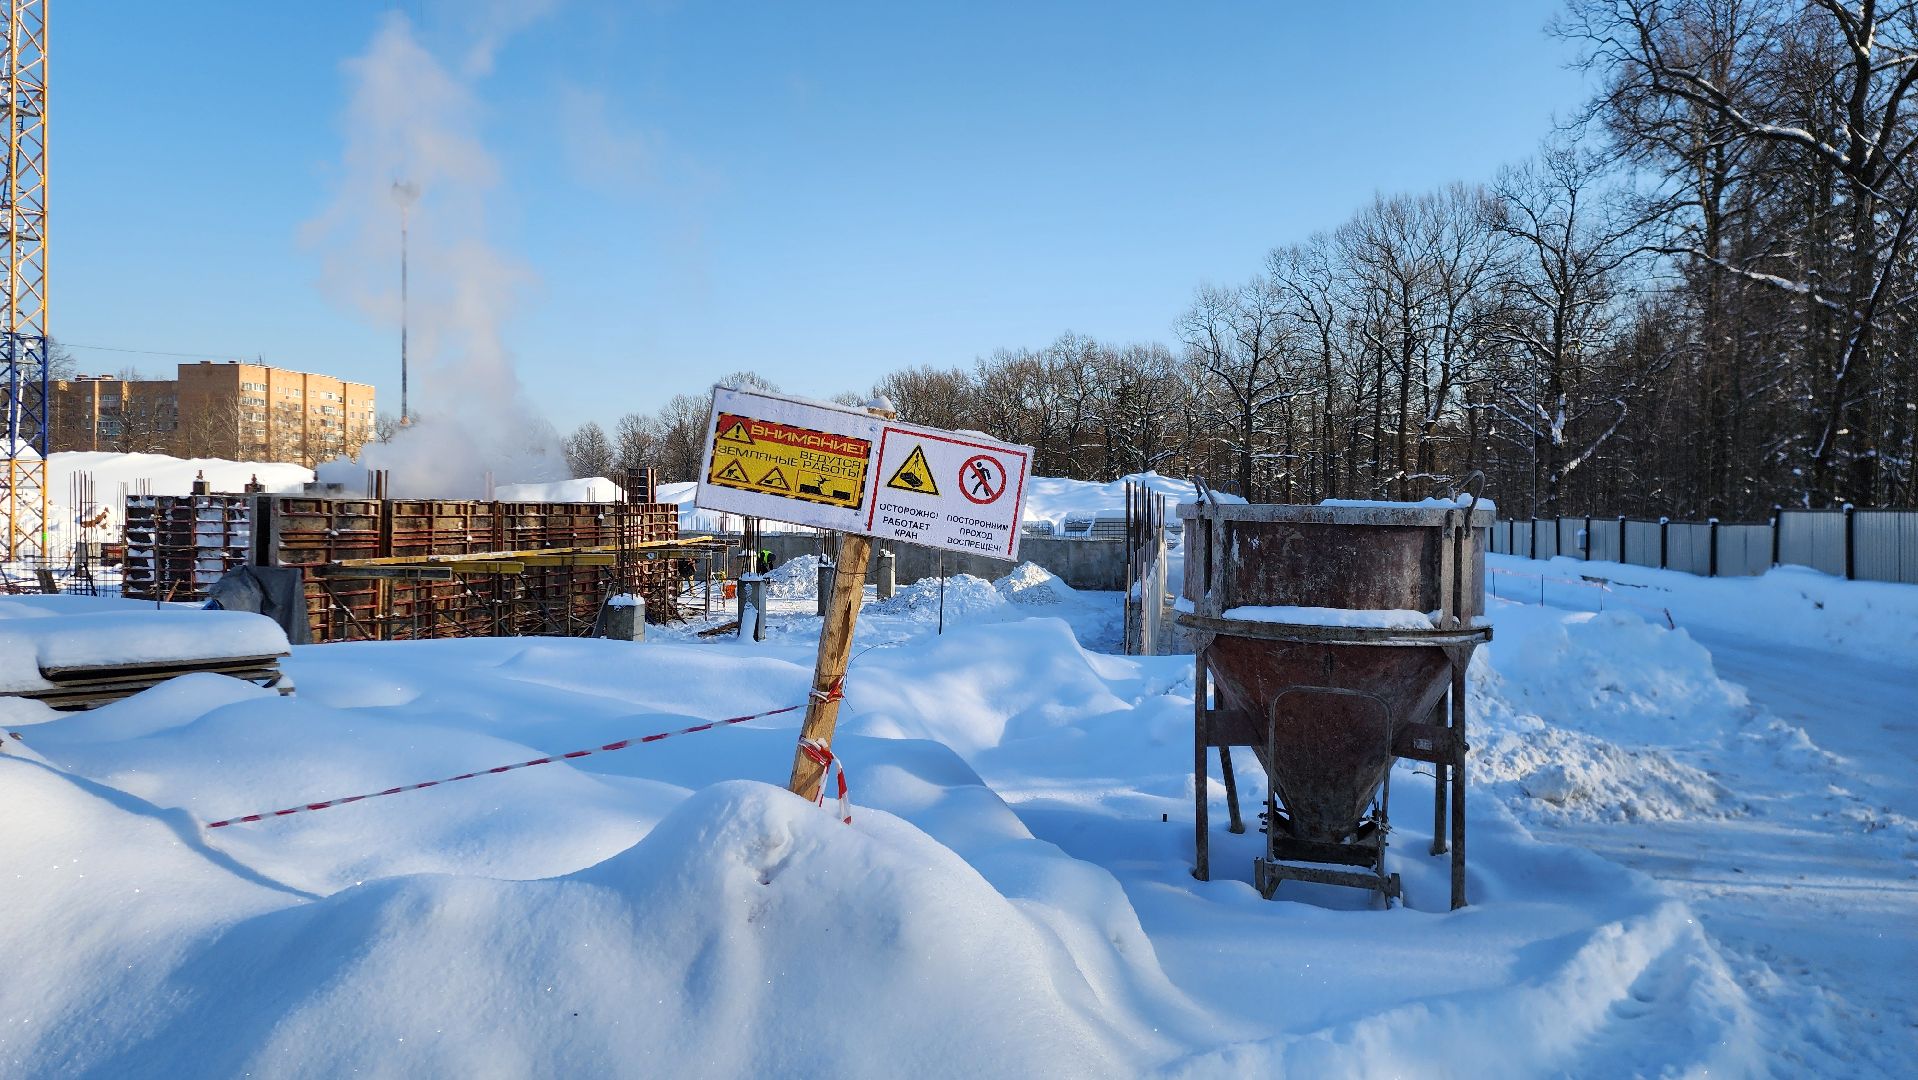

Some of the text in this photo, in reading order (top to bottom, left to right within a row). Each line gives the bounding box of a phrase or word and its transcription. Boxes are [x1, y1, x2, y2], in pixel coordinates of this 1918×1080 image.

[751, 424, 864, 454] ВНИМАНИЕ!
[717, 445, 860, 478] ЗЕМЛЯНЫЕ РАБОТЫ
[800, 450, 861, 469] ВЕДУТСЯ
[879, 503, 939, 519] ОСТОРОЖНО!
[882, 515, 931, 531] РАБОТАЕТ
[946, 514, 1009, 531] ПОСТОРОННИМ
[894, 528, 918, 540] КРАН
[959, 527, 993, 541] ПРОХОД
